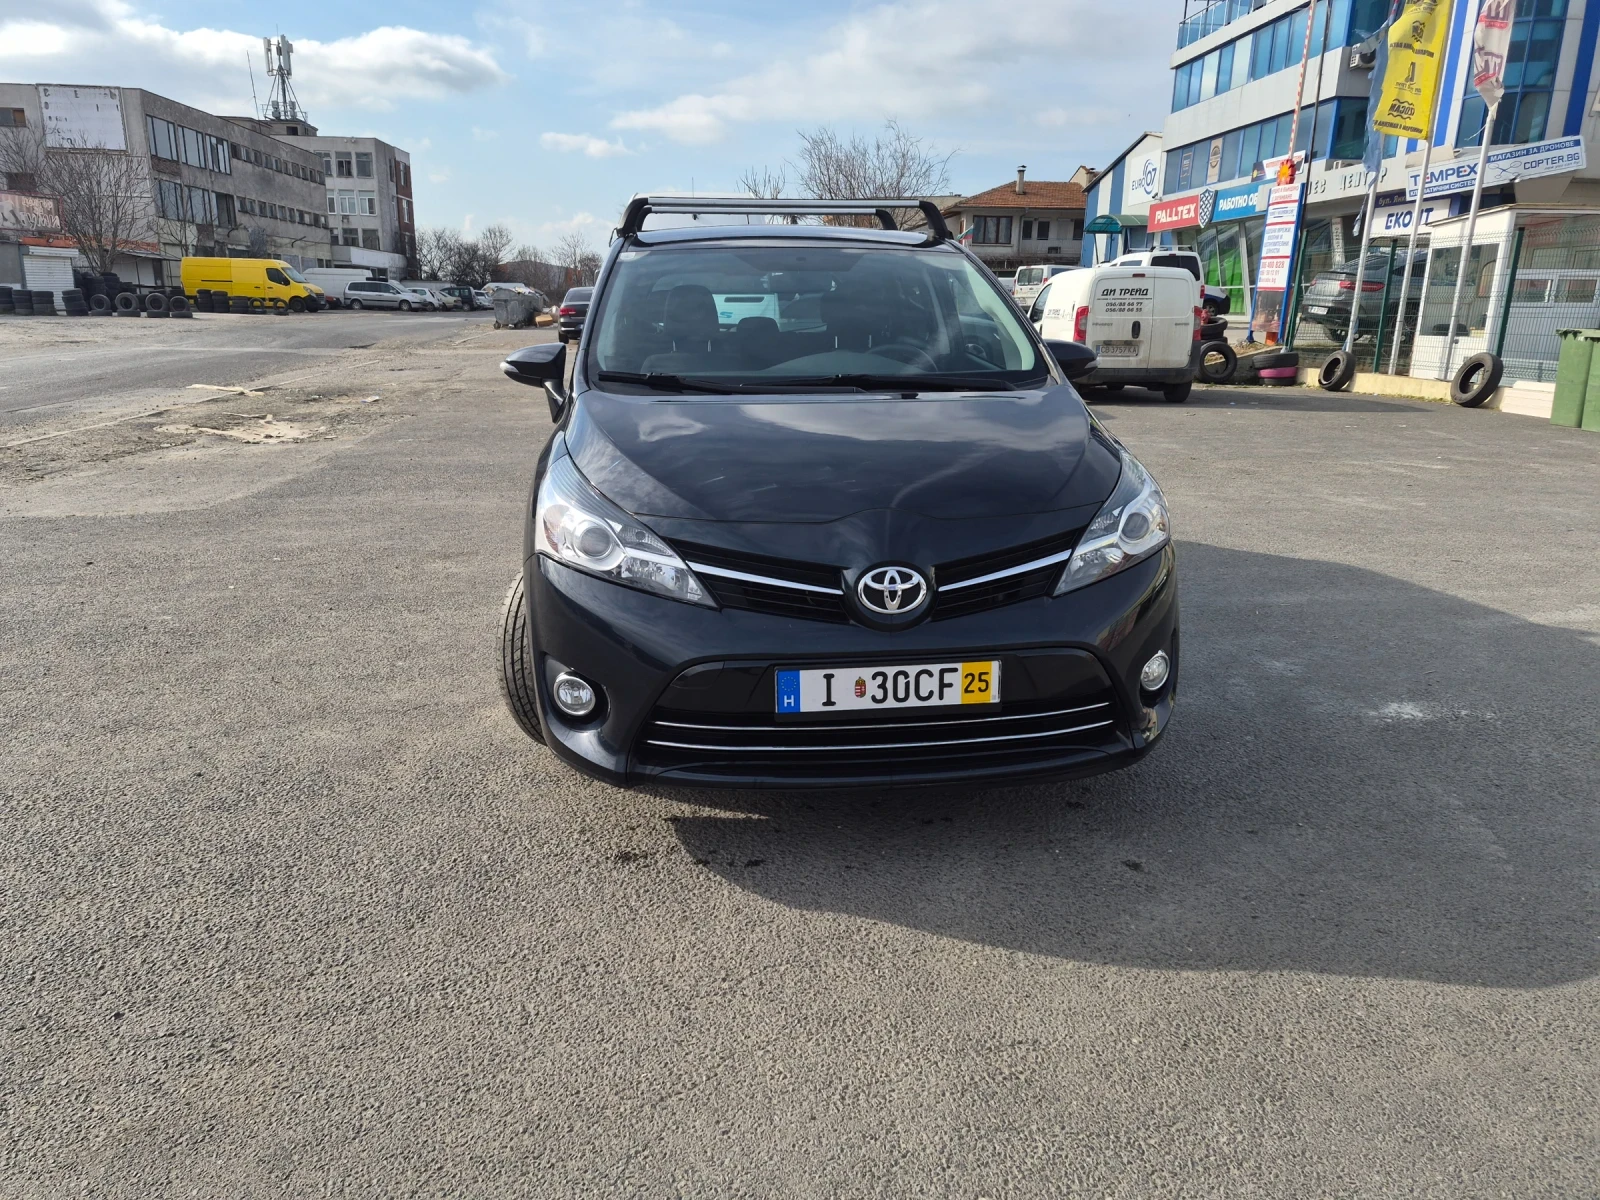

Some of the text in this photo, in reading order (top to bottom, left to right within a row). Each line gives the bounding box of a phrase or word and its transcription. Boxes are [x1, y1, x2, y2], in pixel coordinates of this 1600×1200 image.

[1490, 150, 1527, 162] МАГАЗИН
[1539, 141, 1575, 153] ДРОНОВЕ
[1523, 152, 1580, 170] COPTER.BG
[1131, 177, 1146, 191] EURO
[1340, 167, 1387, 191] ЦЕНТР
[1410, 179, 1477, 197] КЛАТИЧНИ СИСТЕМ
[1218, 194, 1248, 212] РАБОТНО
[1154, 203, 1197, 225] PALLTEX
[1101, 287, 1149, 297] ДИ ТРЕЙД
[1111, 346, 1127, 354] 3757
[871, 667, 959, 704] 30CF
[963, 671, 990, 694] 25
[783, 694, 795, 707] H
